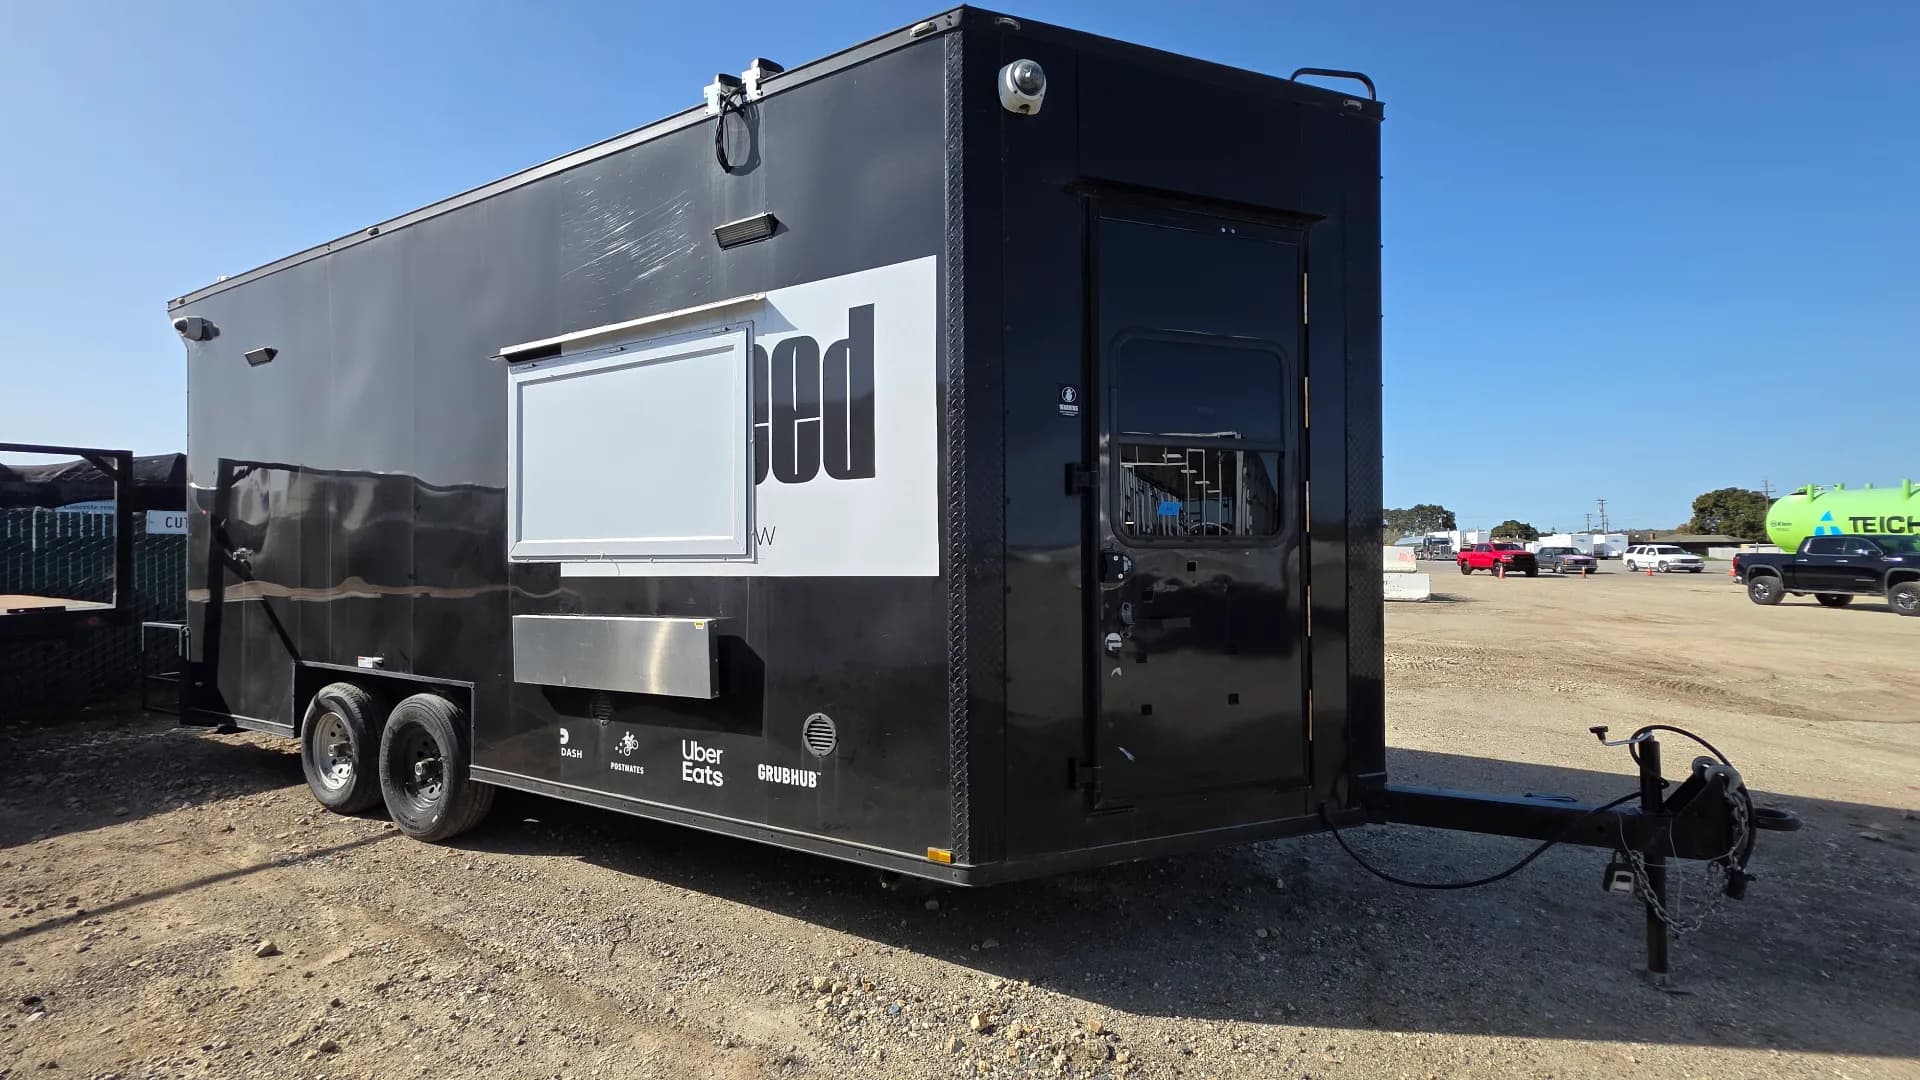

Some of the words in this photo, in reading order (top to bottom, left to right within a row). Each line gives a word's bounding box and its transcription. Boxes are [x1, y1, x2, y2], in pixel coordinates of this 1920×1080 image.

[1848, 516, 1920, 534] TEICH
[561, 747, 583, 759] DASH
[682, 739, 724, 765] Uber
[610, 761, 645, 775] POSTMATES
[682, 760, 724, 787] Eats
